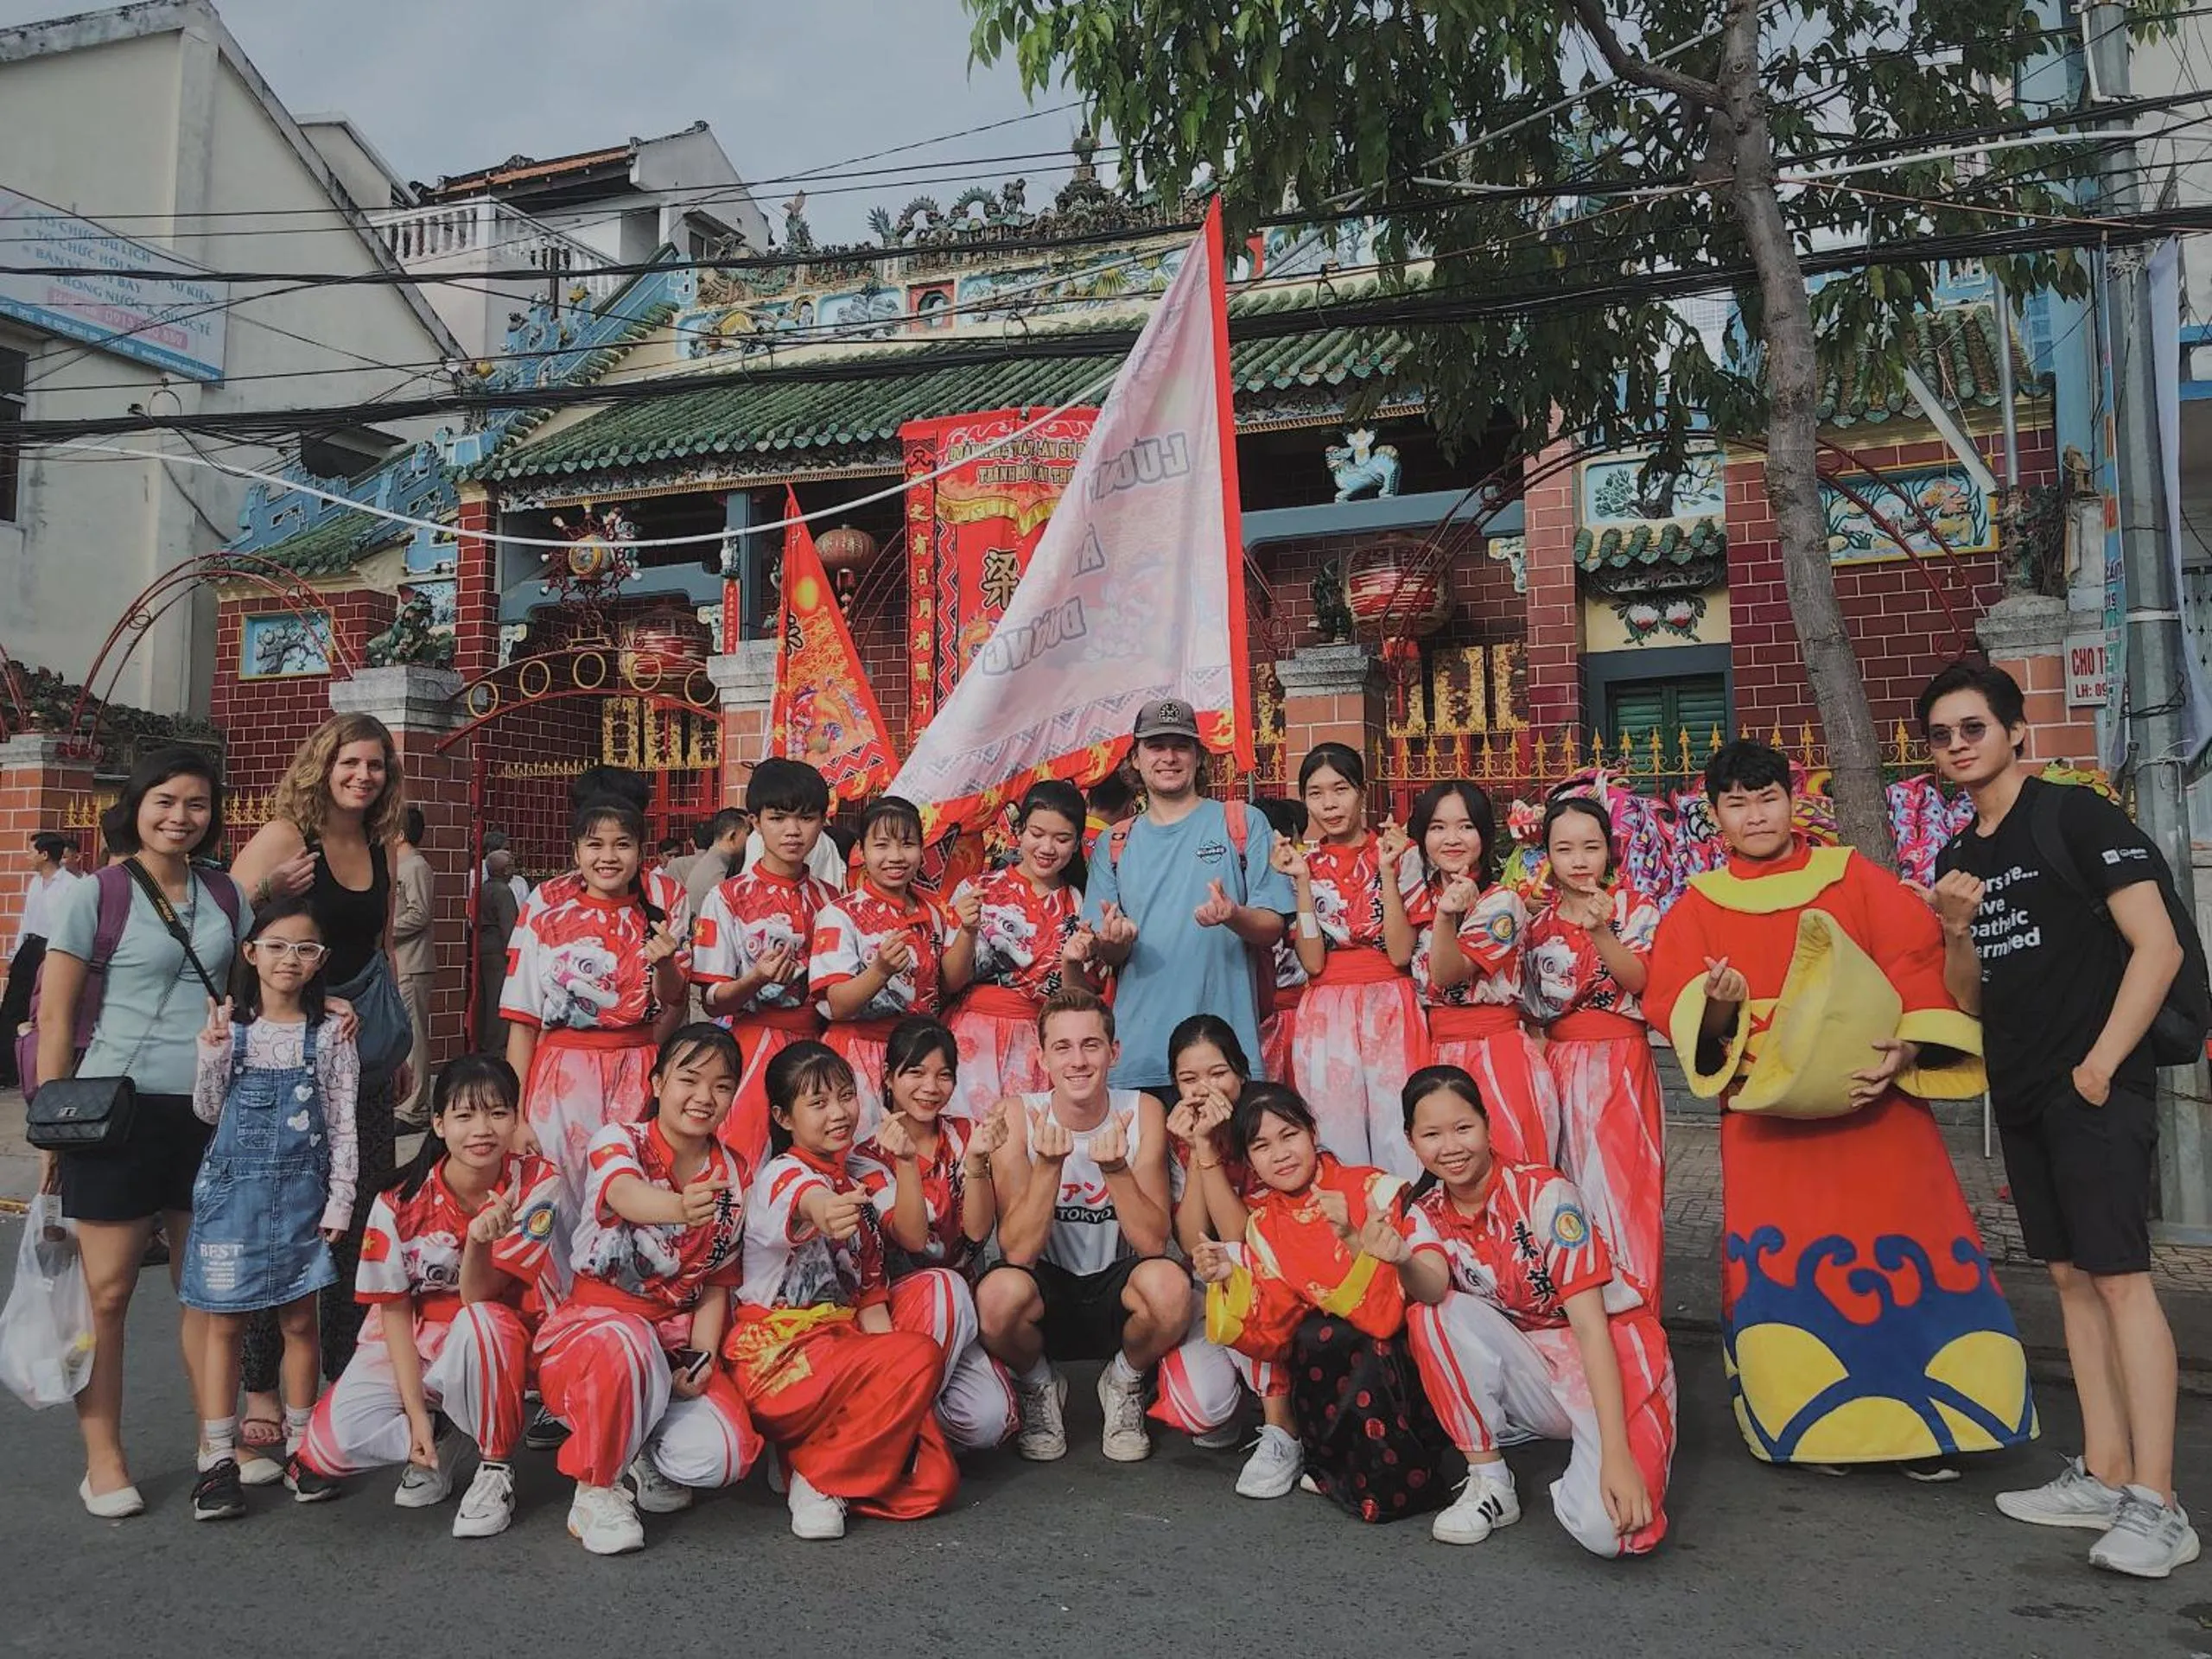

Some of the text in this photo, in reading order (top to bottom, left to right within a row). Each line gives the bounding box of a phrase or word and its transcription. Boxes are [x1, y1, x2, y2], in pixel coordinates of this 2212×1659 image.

[2072, 648, 2094, 676] CHO
[2094, 683, 2107, 697] 09
[1059, 1209, 1112, 1223] TOKYO
[200, 1243, 245, 1258] BEST
